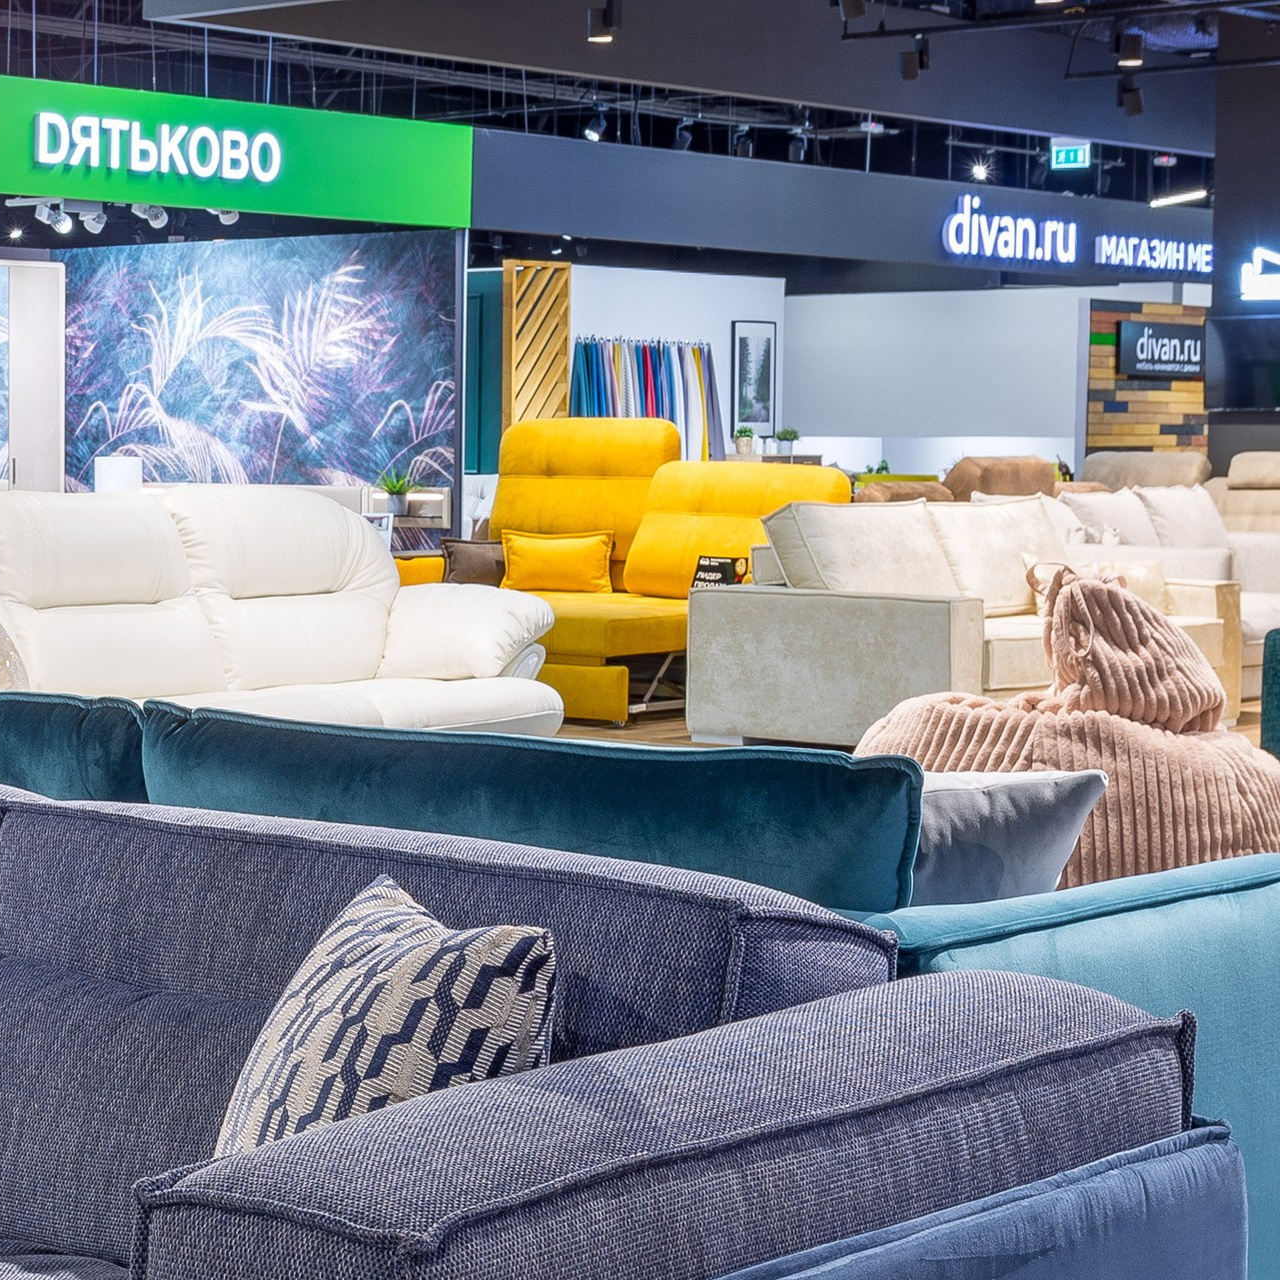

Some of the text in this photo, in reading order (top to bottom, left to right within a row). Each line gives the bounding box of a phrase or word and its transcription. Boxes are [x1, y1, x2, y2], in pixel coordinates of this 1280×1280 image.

[943, 194, 1077, 263] divan.ru
[1096, 235, 1213, 273] МАГАЗИН МЕ
[1136, 326, 1201, 362] divan.ru
[696, 571, 722, 580] ЛИДЕР
